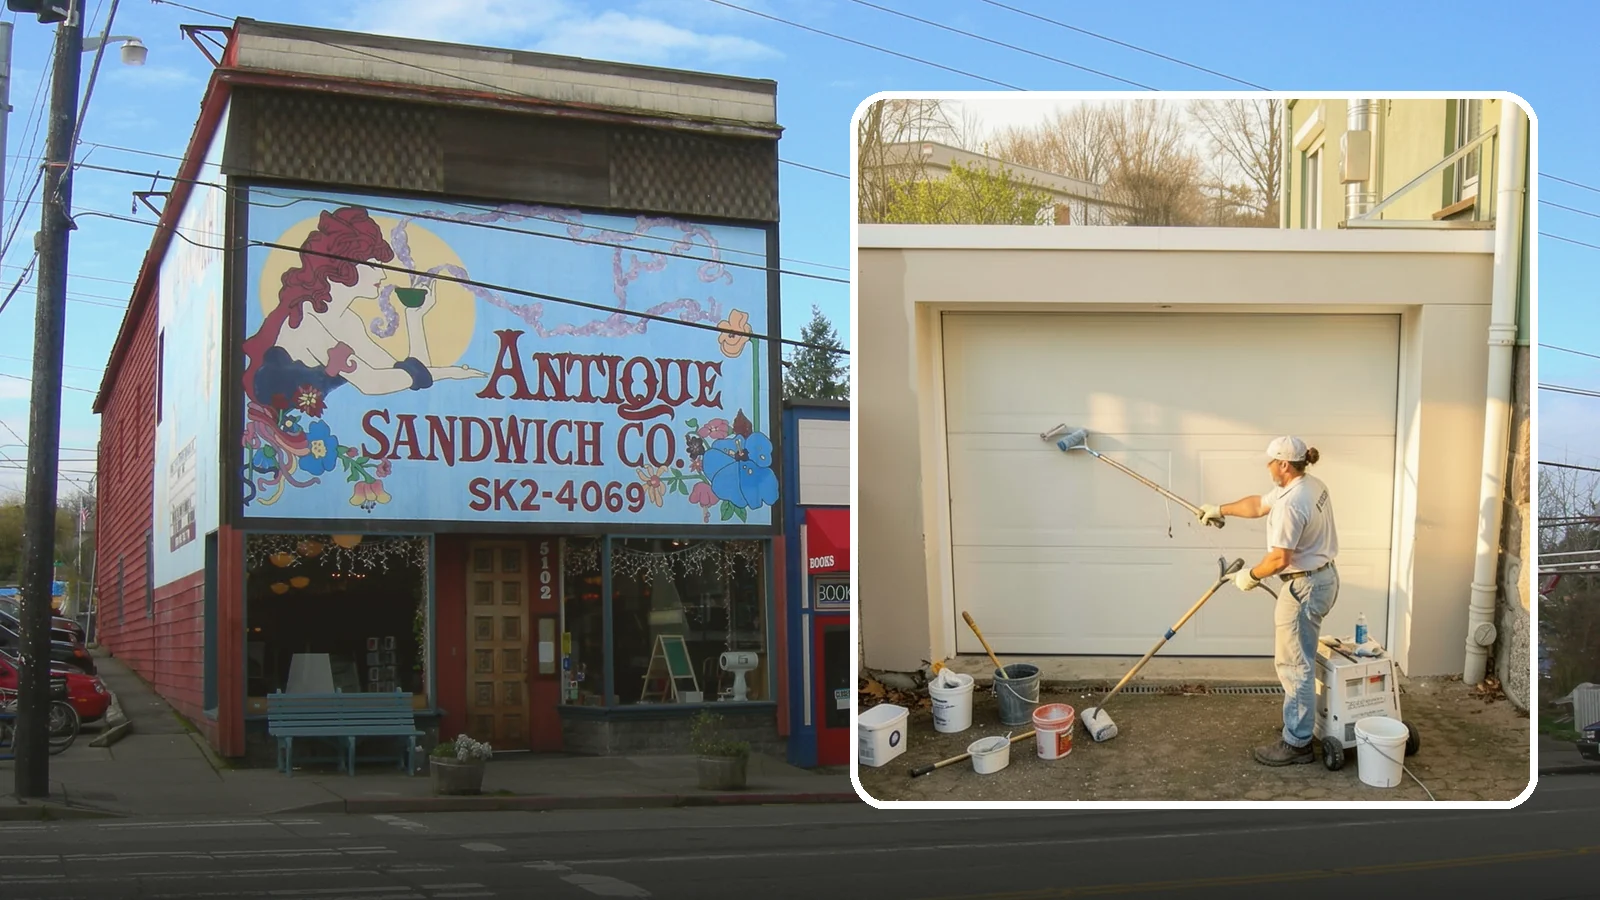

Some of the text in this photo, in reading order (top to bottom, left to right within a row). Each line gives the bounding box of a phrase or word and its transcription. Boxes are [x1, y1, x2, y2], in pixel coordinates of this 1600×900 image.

[475, 329, 724, 422] ANTIQUE
[361, 408, 685, 468] SANDWICH CO.
[468, 477, 646, 513] SK2-4069
[540, 541, 551, 600] 5102
[809, 555, 835, 569] BOOKS
